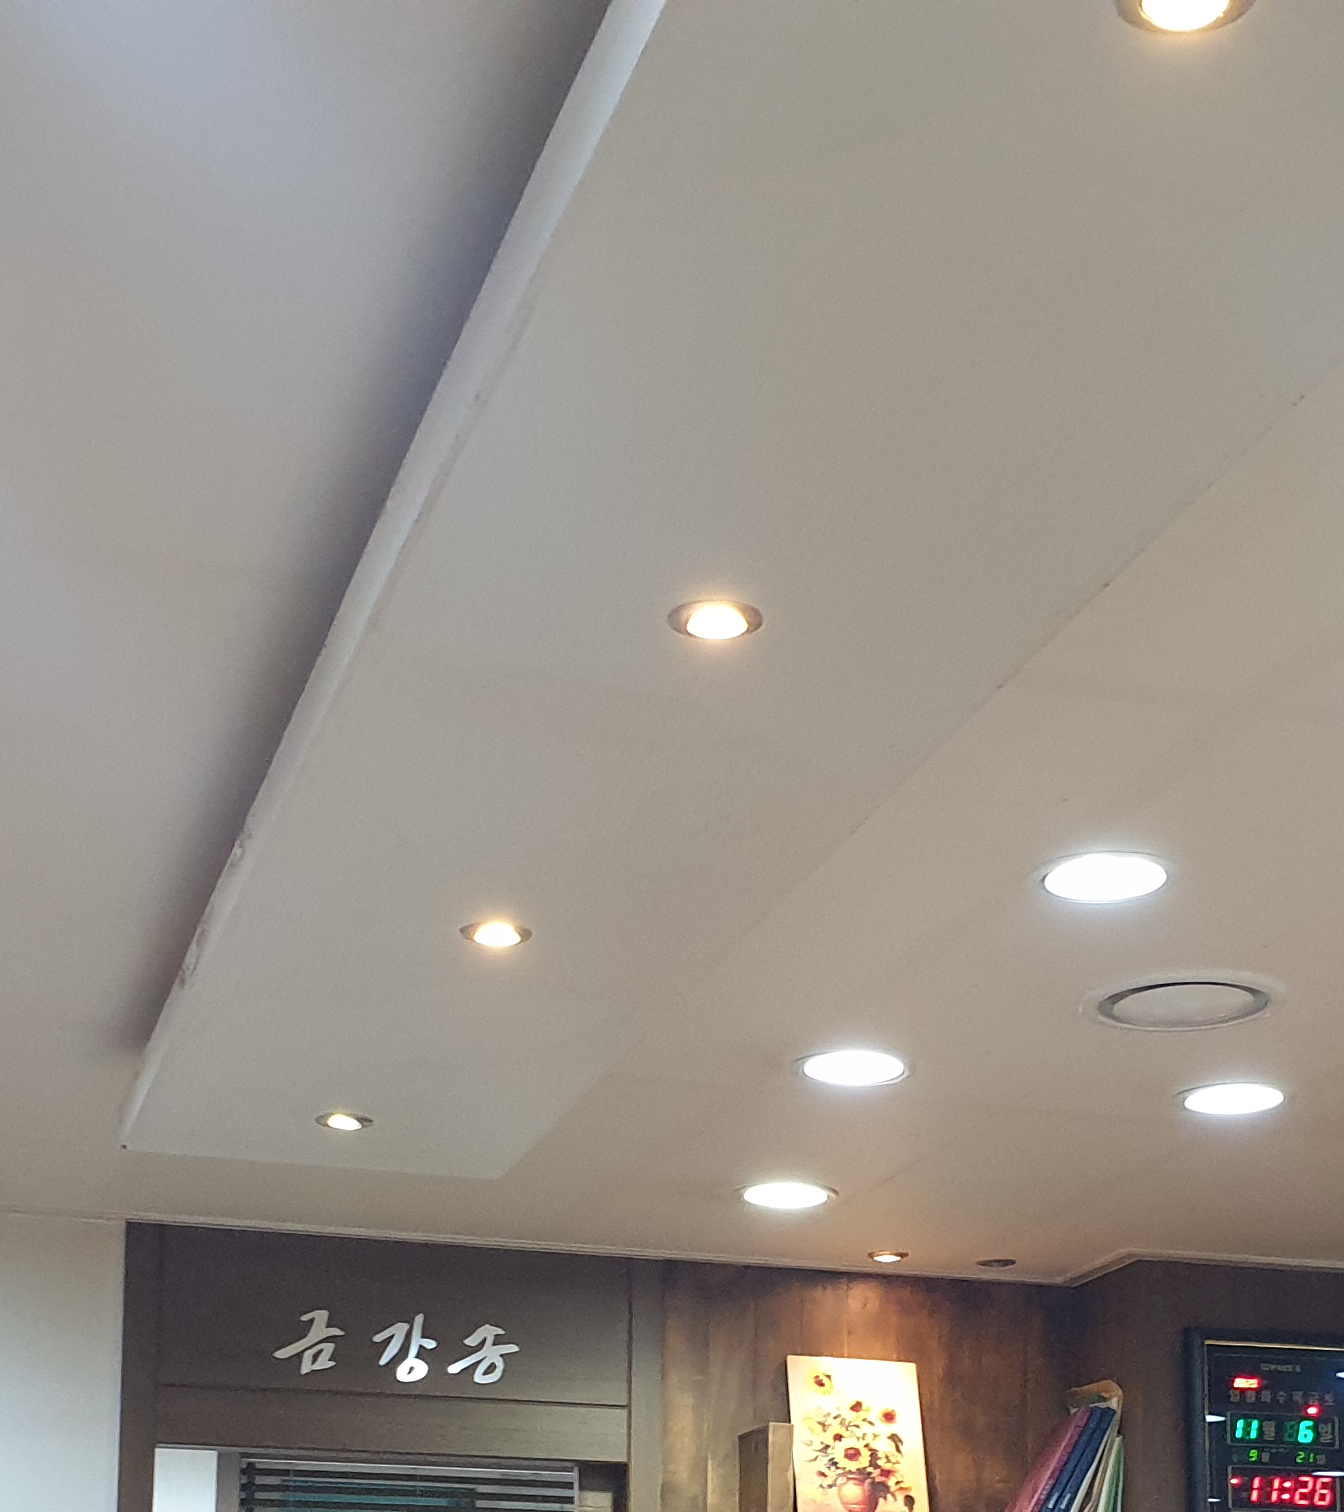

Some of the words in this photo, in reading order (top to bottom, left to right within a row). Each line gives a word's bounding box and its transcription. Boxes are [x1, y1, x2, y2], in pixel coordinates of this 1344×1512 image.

[1235, 1418, 1258, 1439] 11
[1297, 1420, 1314, 1443] 6
[1249, 1476, 1335, 1506] 11:26
